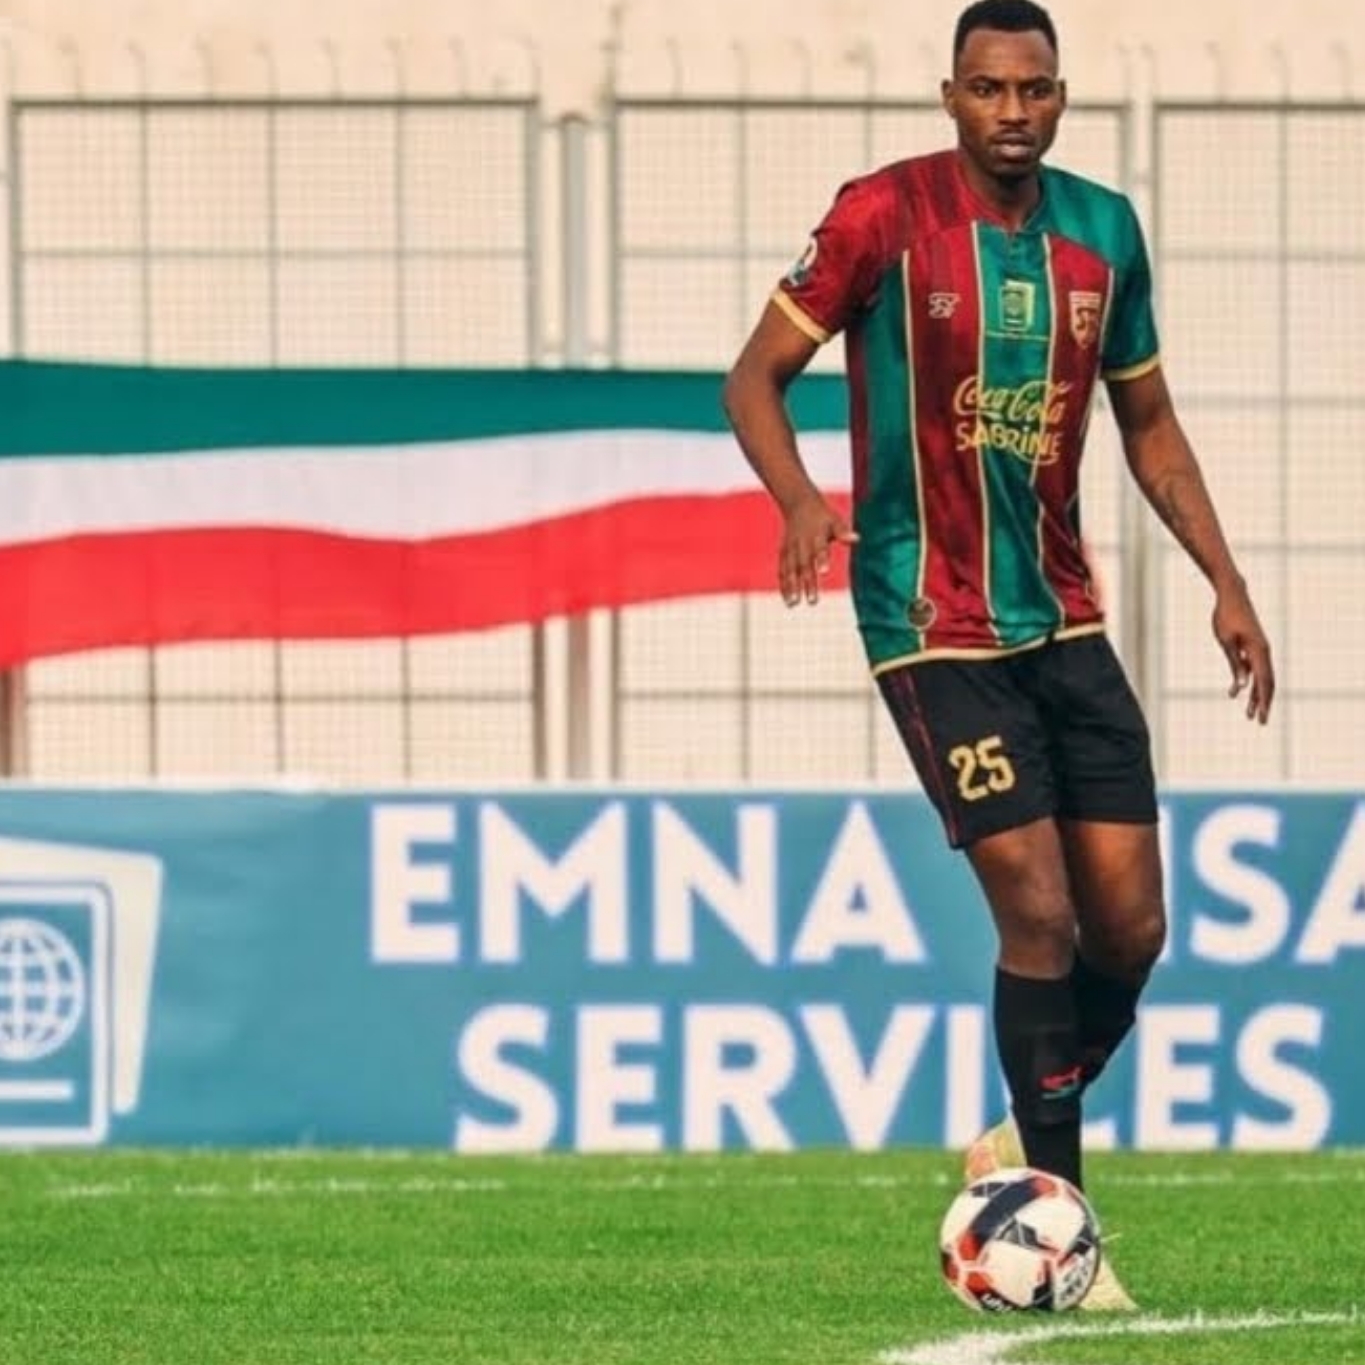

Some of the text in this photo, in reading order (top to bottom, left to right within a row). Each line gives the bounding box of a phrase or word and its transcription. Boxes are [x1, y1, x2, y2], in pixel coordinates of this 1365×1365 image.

[948, 735, 1015, 802] 25
[370, 801, 927, 965] EMNA
[455, 1003, 1333, 1153] SERVIES
